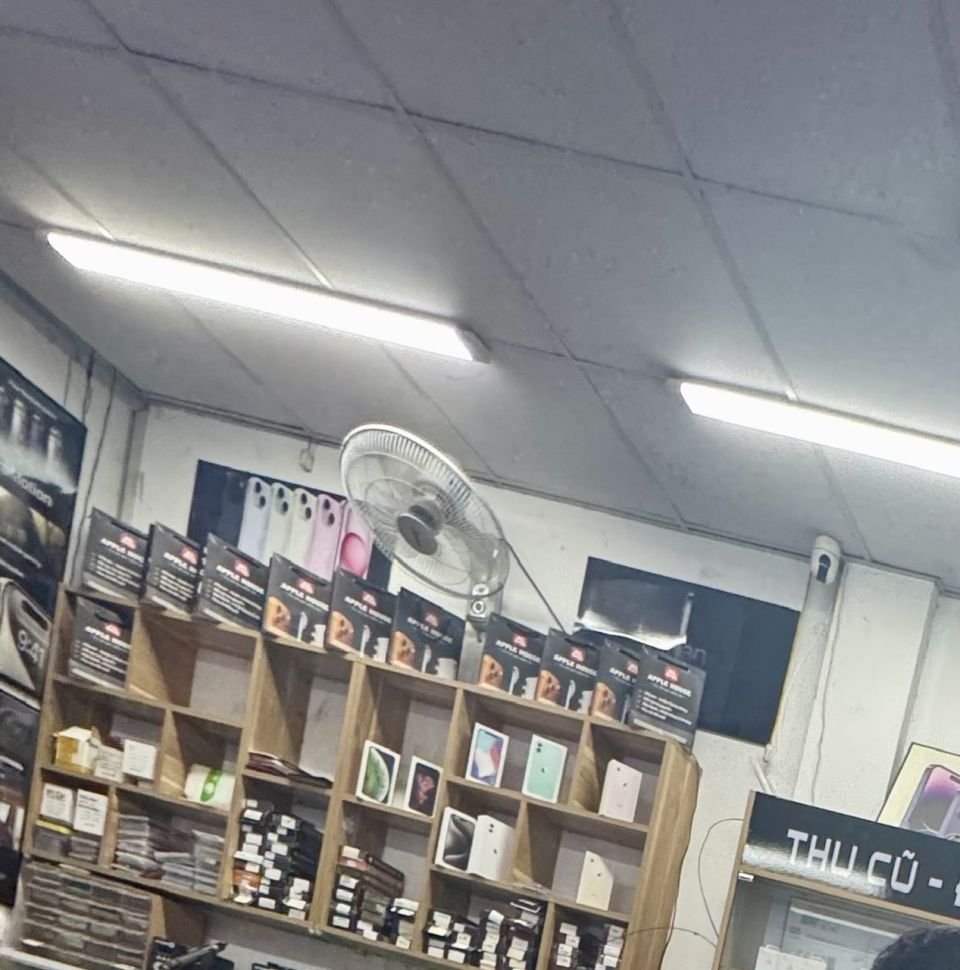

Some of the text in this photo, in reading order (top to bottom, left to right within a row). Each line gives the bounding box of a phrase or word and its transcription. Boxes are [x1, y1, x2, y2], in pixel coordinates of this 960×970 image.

[786, 829, 858, 879] THU
[867, 849, 919, 895] CŨ
[928, 875, 943, 889] -
